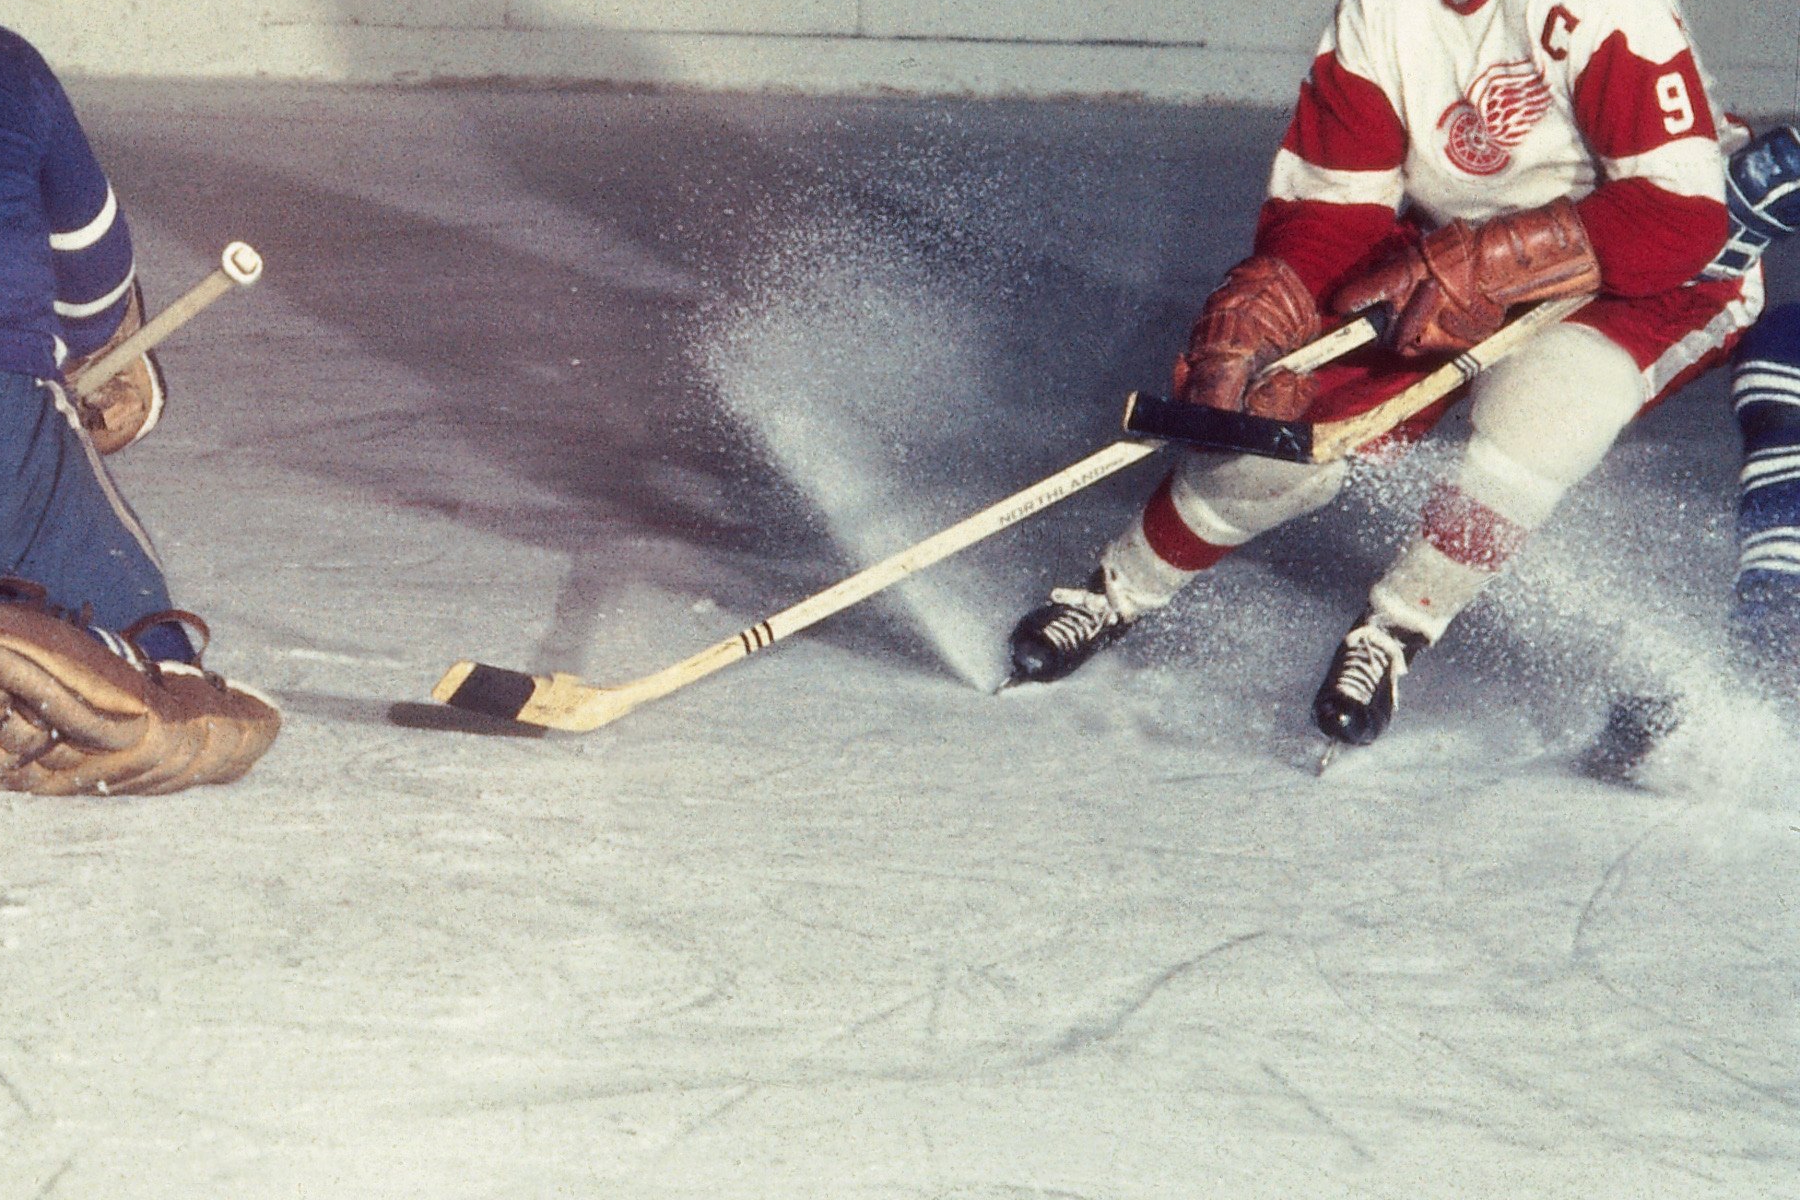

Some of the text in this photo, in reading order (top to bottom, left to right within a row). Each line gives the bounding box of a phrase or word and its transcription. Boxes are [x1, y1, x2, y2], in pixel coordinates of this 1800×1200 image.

[1541, 4, 1581, 61] C
[1655, 71, 1695, 135] 9
[999, 464, 1105, 525] NORTHLAND
